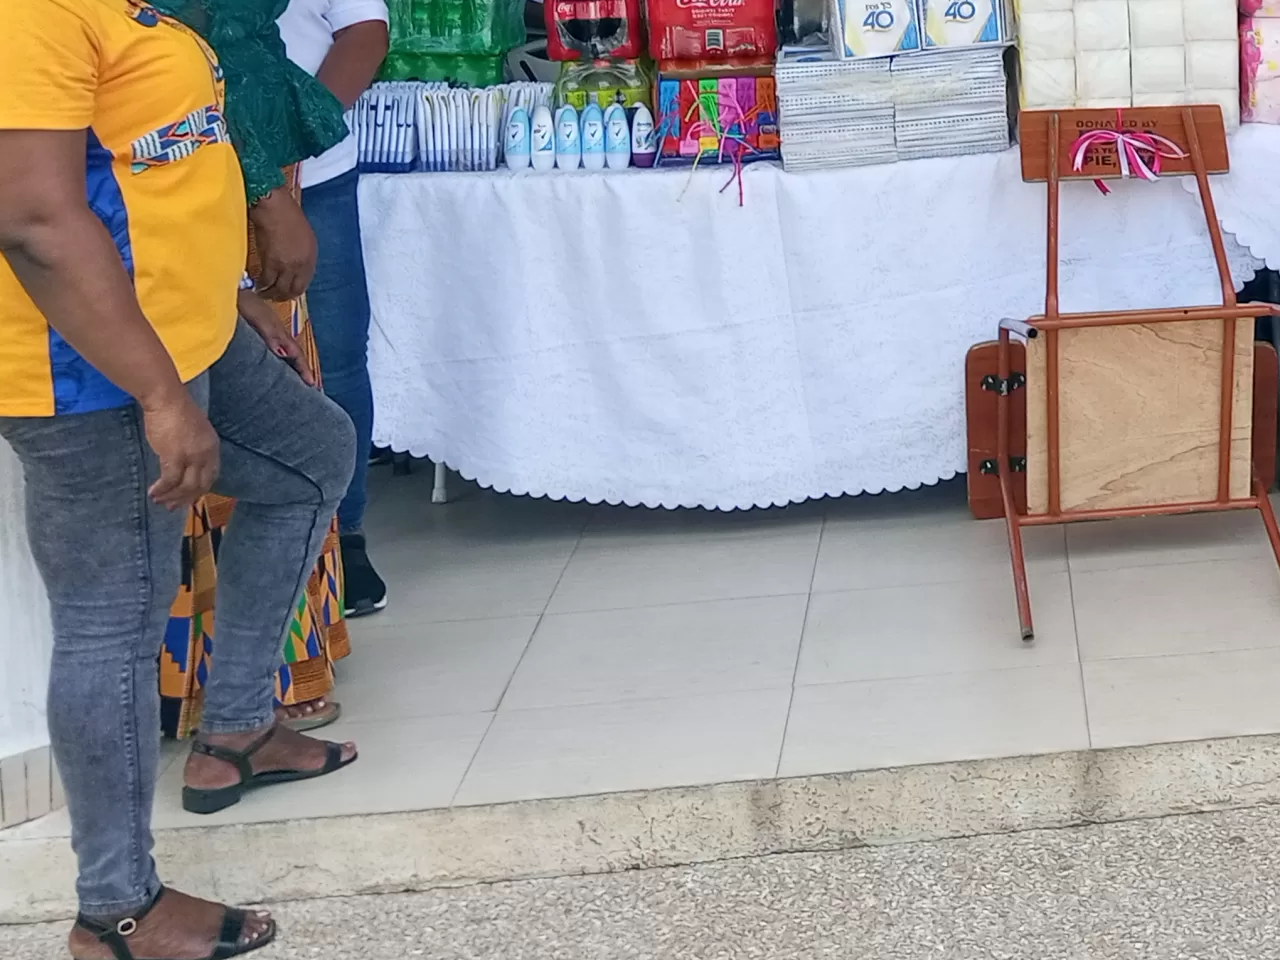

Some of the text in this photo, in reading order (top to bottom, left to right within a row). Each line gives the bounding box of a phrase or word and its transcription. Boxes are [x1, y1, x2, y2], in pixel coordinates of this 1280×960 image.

[944, 1, 976, 19] 40
[863, 10, 894, 29] 40
[1076, 119, 1137, 128] DONAED
